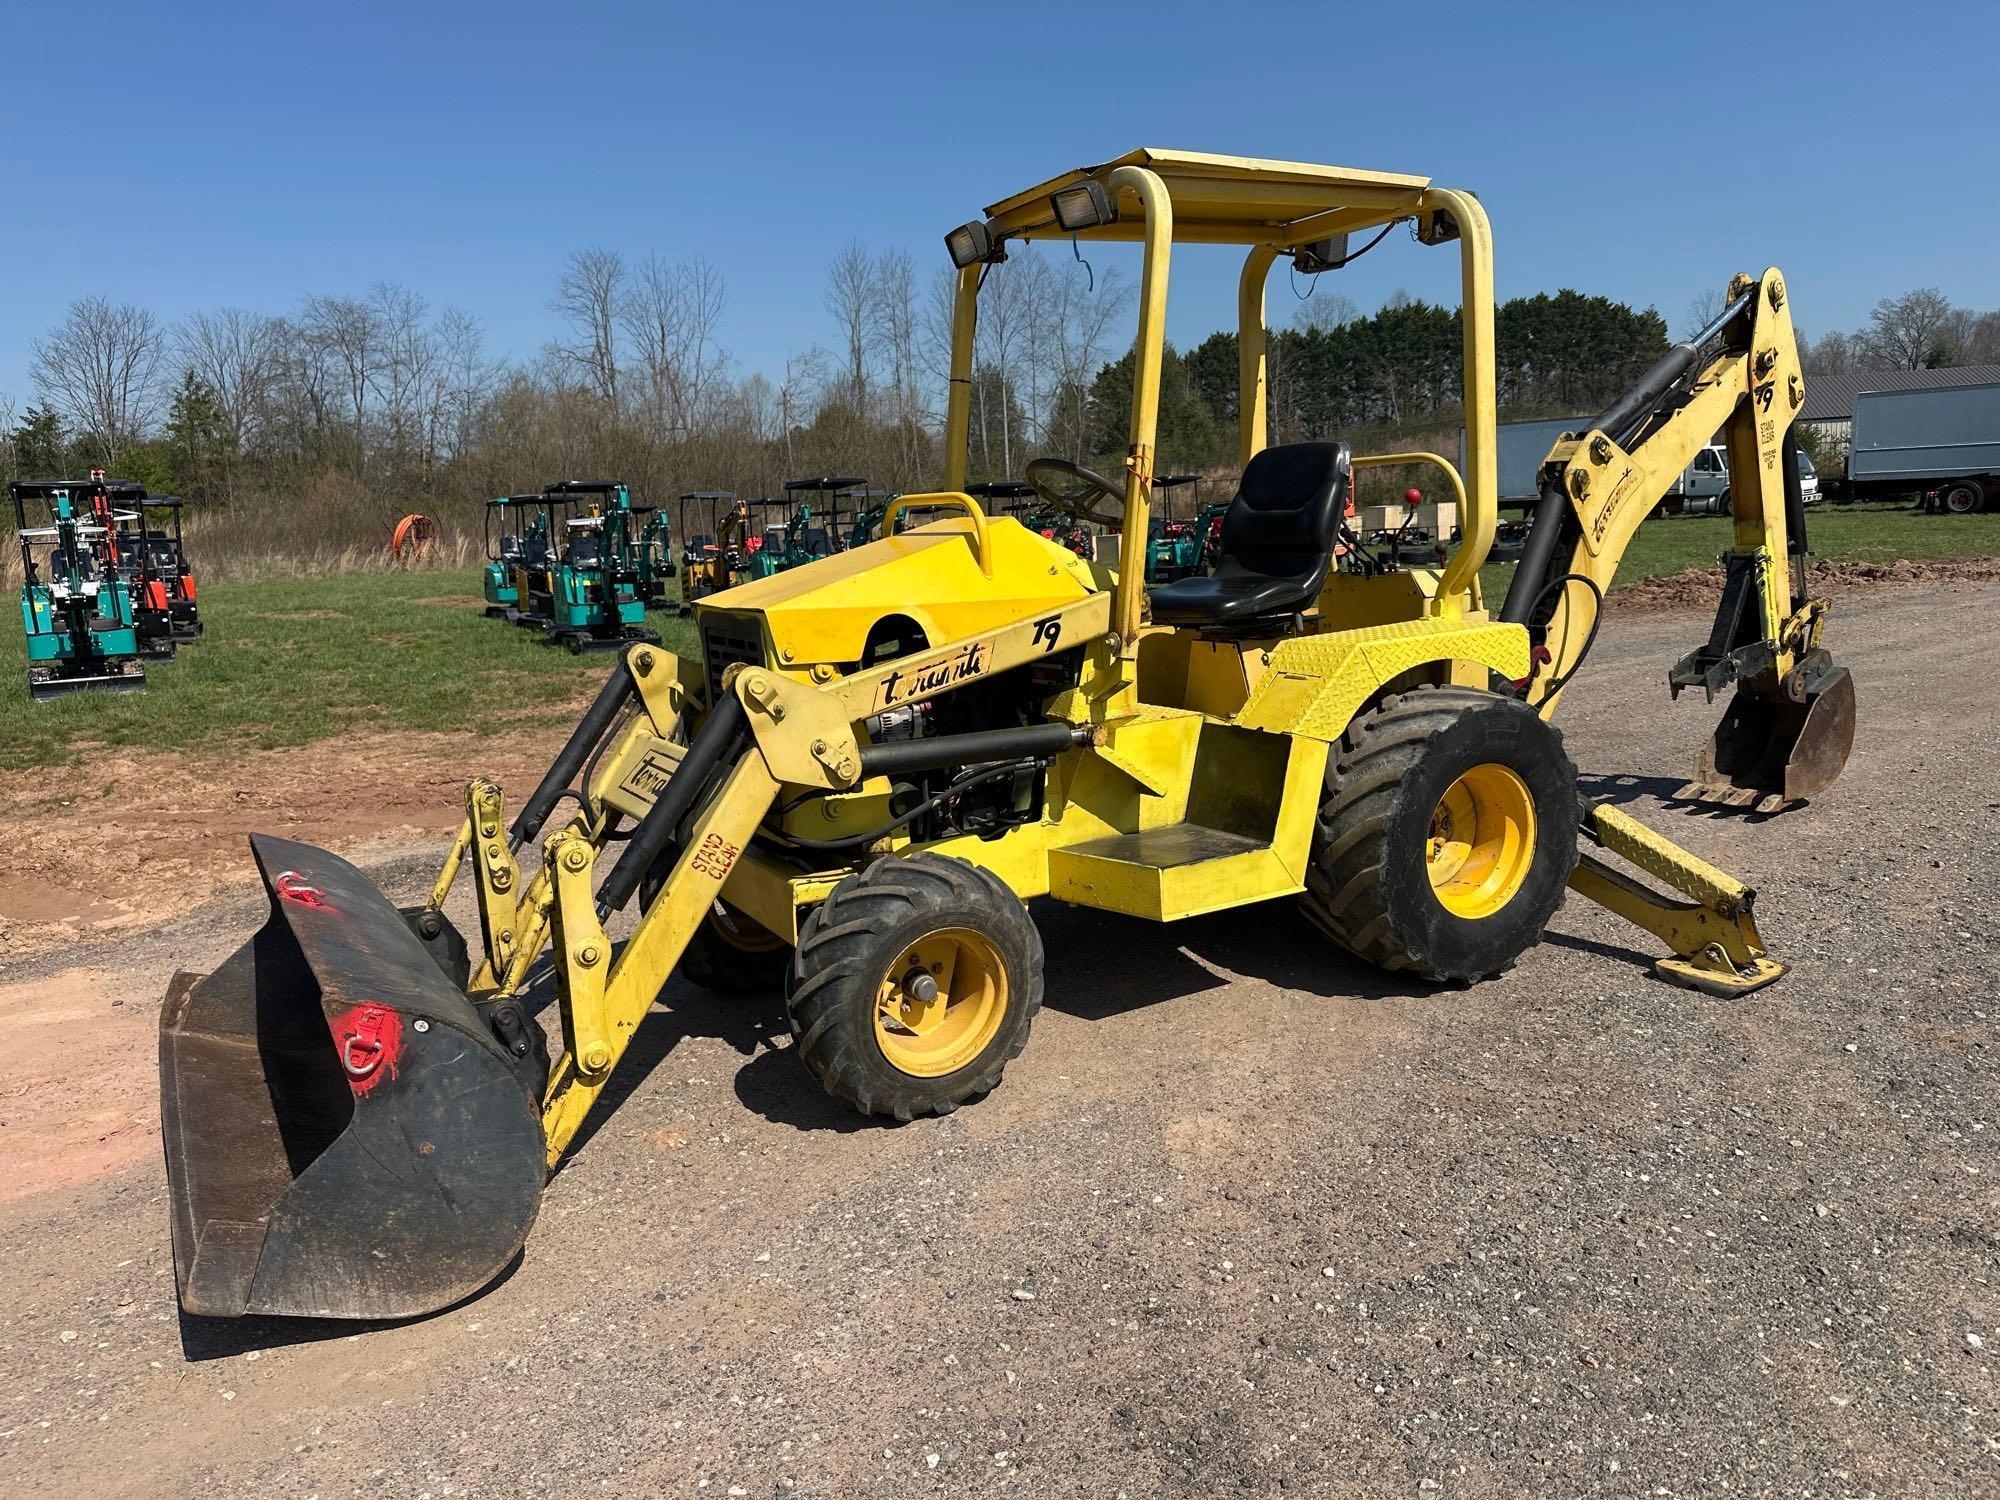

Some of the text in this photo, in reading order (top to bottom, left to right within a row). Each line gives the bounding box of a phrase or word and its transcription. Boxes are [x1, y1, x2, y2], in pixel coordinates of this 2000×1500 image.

[1754, 380, 1775, 413] T9
[1032, 613, 1062, 652] T9
[691, 833, 723, 872] STAND
[708, 842, 739, 880] CLEAR
